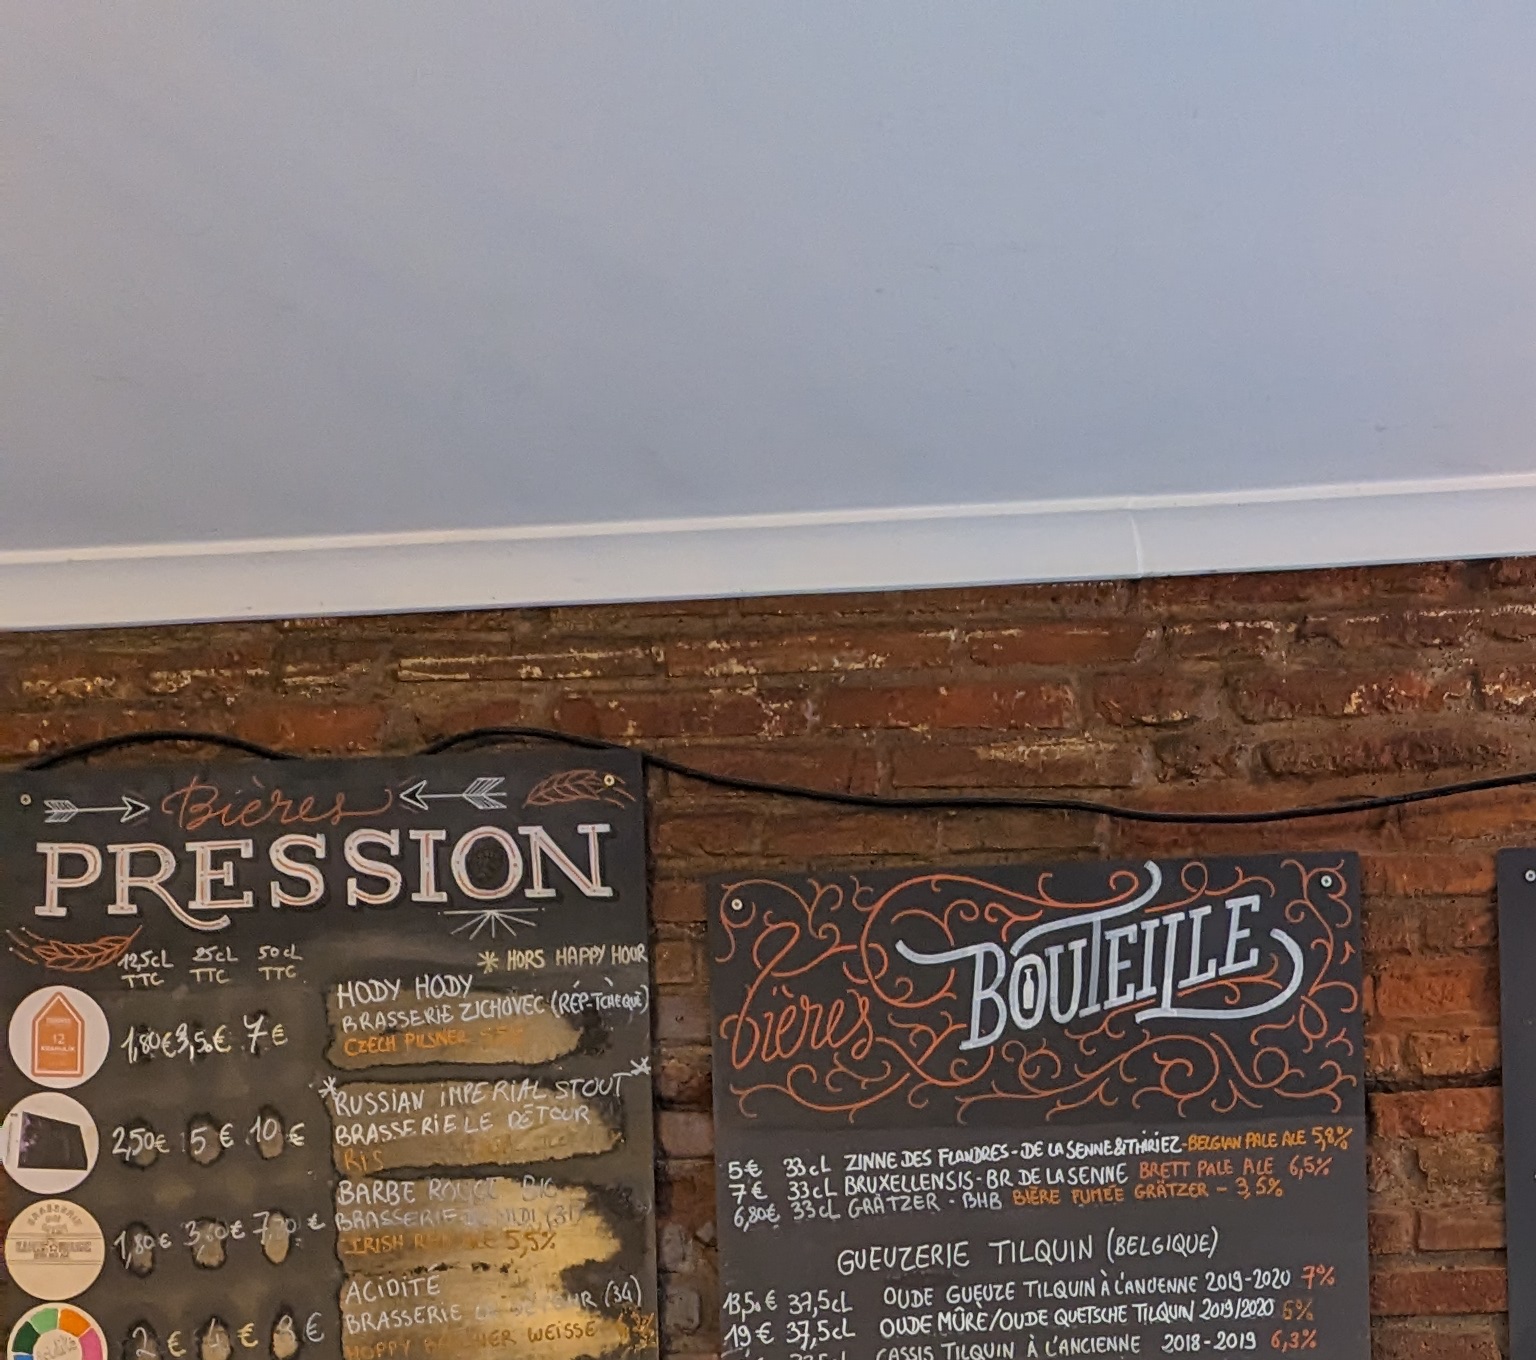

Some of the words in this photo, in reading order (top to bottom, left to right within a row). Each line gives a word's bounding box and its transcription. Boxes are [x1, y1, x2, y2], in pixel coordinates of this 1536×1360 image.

[35, 823, 613, 930] PRESSION
[507, 949, 545, 971] HORS
[556, 944, 605, 966] HAPPY
[611, 943, 648, 965] HOUR
[896, 861, 1303, 1050] BOUTEILLE
[122, 972, 164, 988] TTC
[337, 979, 400, 1010] HODY
[416, 973, 475, 1001] HODY
[339, 1001, 454, 1033] BRASSERIE
[844, 1152, 897, 1171] ZINNE
[938, 1144, 1009, 1167] FLANDRES
[1140, 1160, 1190, 1179] BRETT
[1198, 1159, 1233, 1177] PALE
[1243, 1157, 1273, 1175] ALE
[838, 1241, 969, 1275] GUEUZERIE
[989, 1235, 1092, 1265] TILQUIN
[1108, 1226, 1218, 1263] (BELGIQUE)
[884, 1287, 933, 1309] OUDE
[1023, 1278, 1095, 1298] TILQUIN
[941, 1334, 1014, 1360] TILQUIN
[1046, 1334, 1140, 1357] L'ANCIENNE
